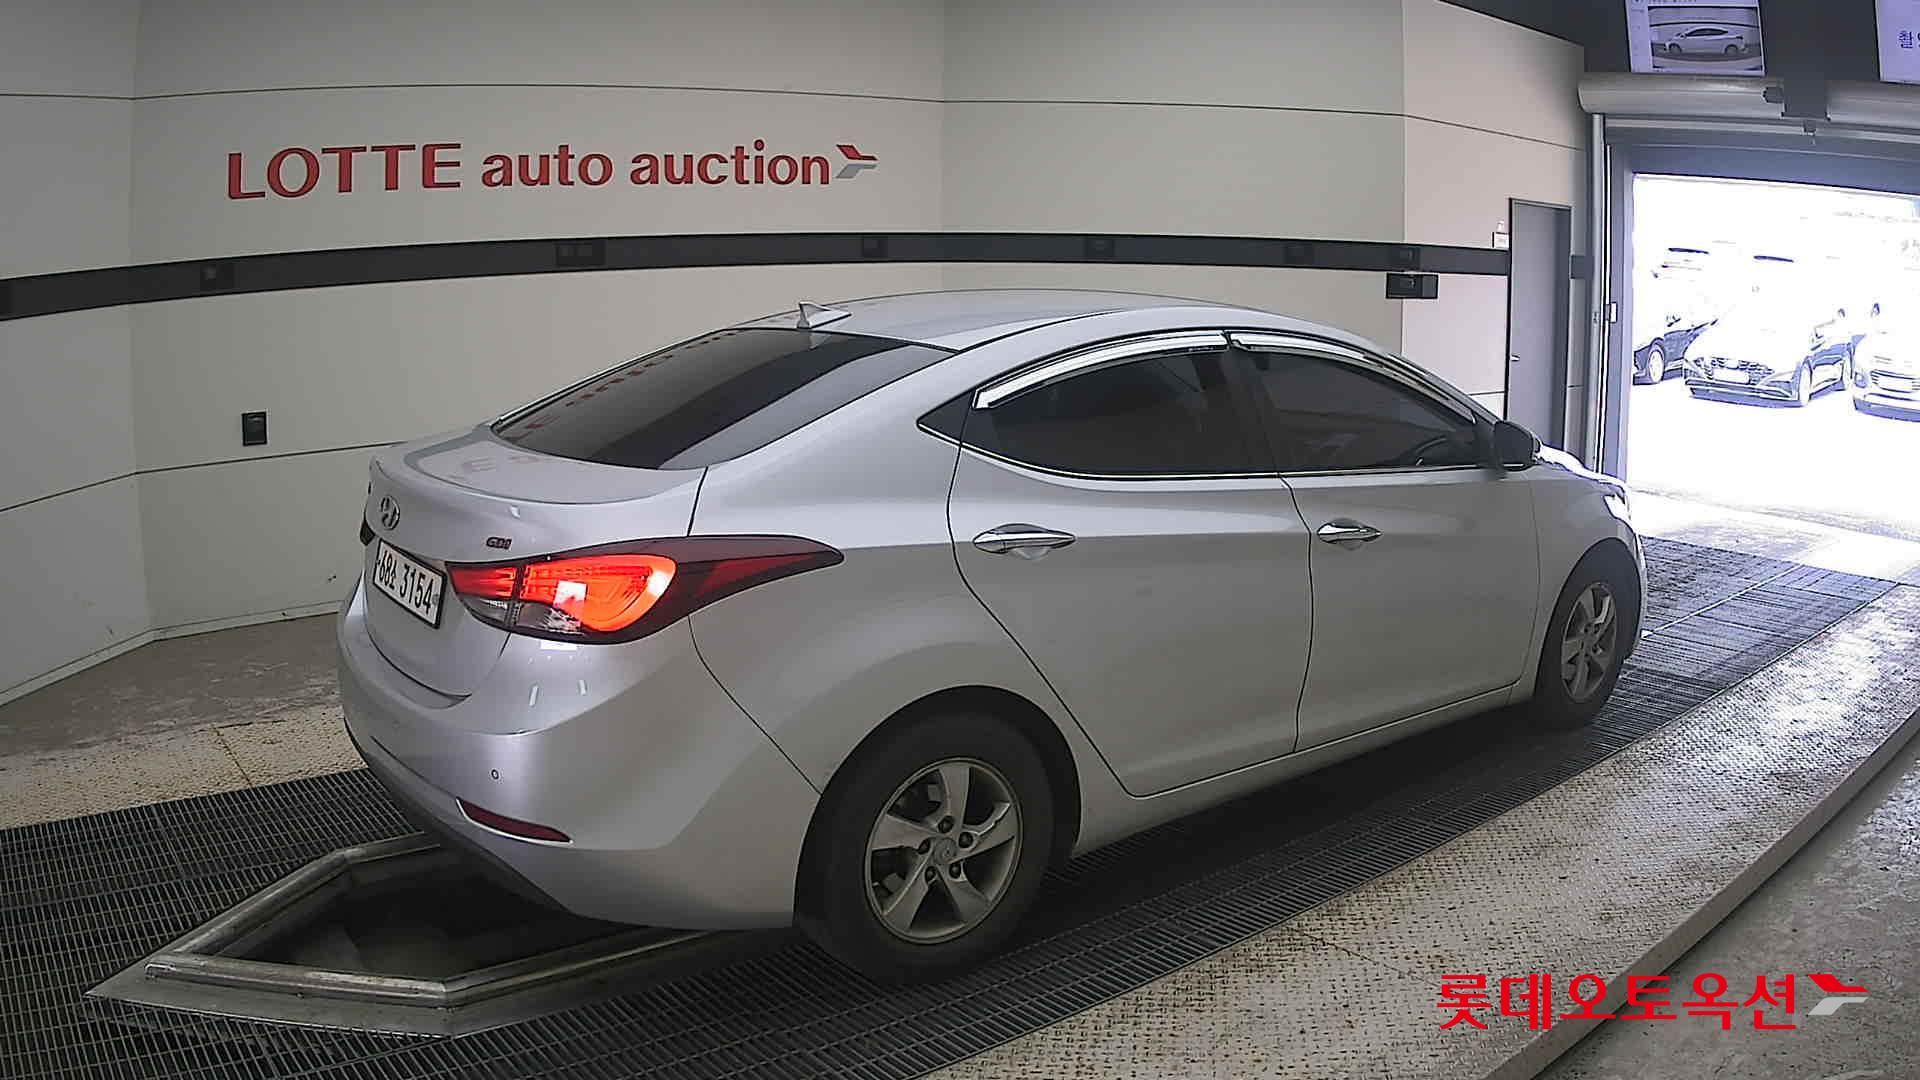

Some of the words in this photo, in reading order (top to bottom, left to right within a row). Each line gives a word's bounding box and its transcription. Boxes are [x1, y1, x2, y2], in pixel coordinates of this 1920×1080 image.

[226, 143, 462, 199] LOTTE
[481, 143, 613, 188] auto
[629, 139, 831, 186] auction
[400, 563, 433, 614] 3154
